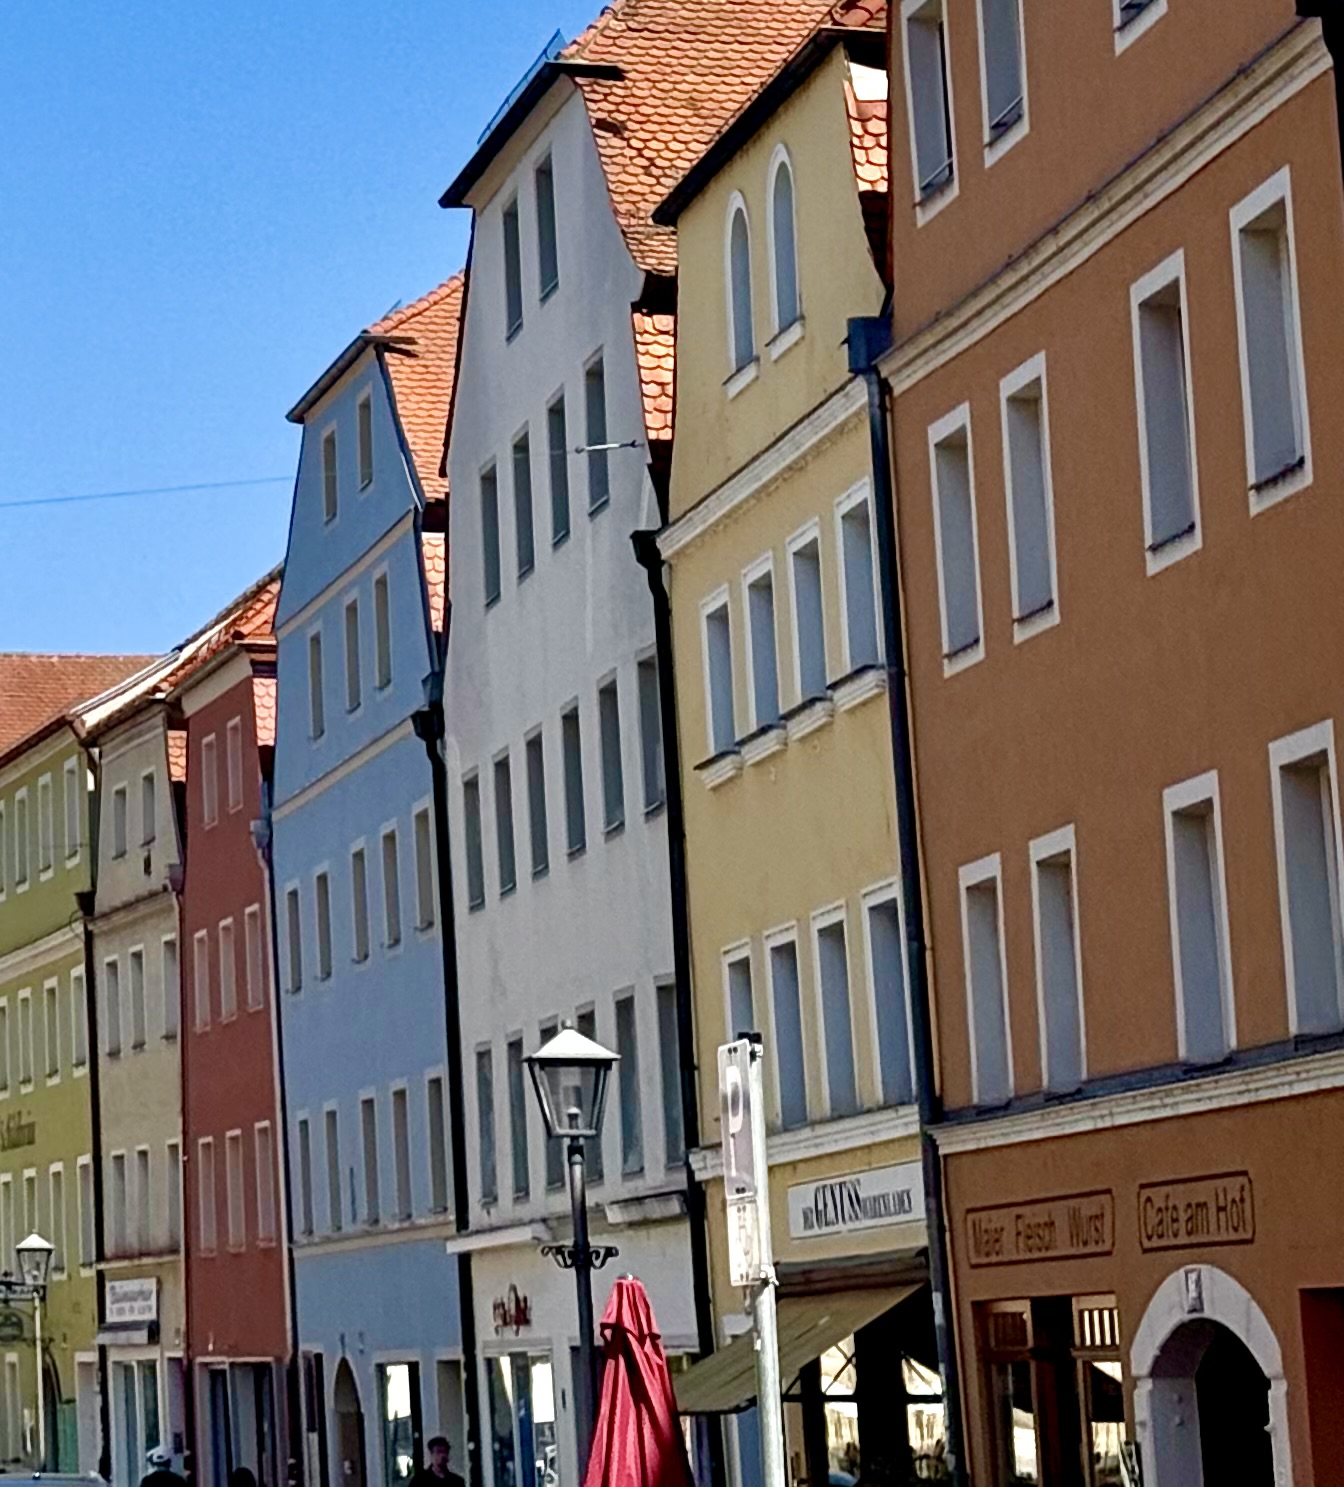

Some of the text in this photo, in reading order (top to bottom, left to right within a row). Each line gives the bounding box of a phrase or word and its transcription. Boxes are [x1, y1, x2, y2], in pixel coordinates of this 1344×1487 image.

[1014, 1212, 1058, 1254] Fleisch
[1066, 1204, 1105, 1249] Wurst
[1142, 1184, 1248, 1241] Cafe am Hof
